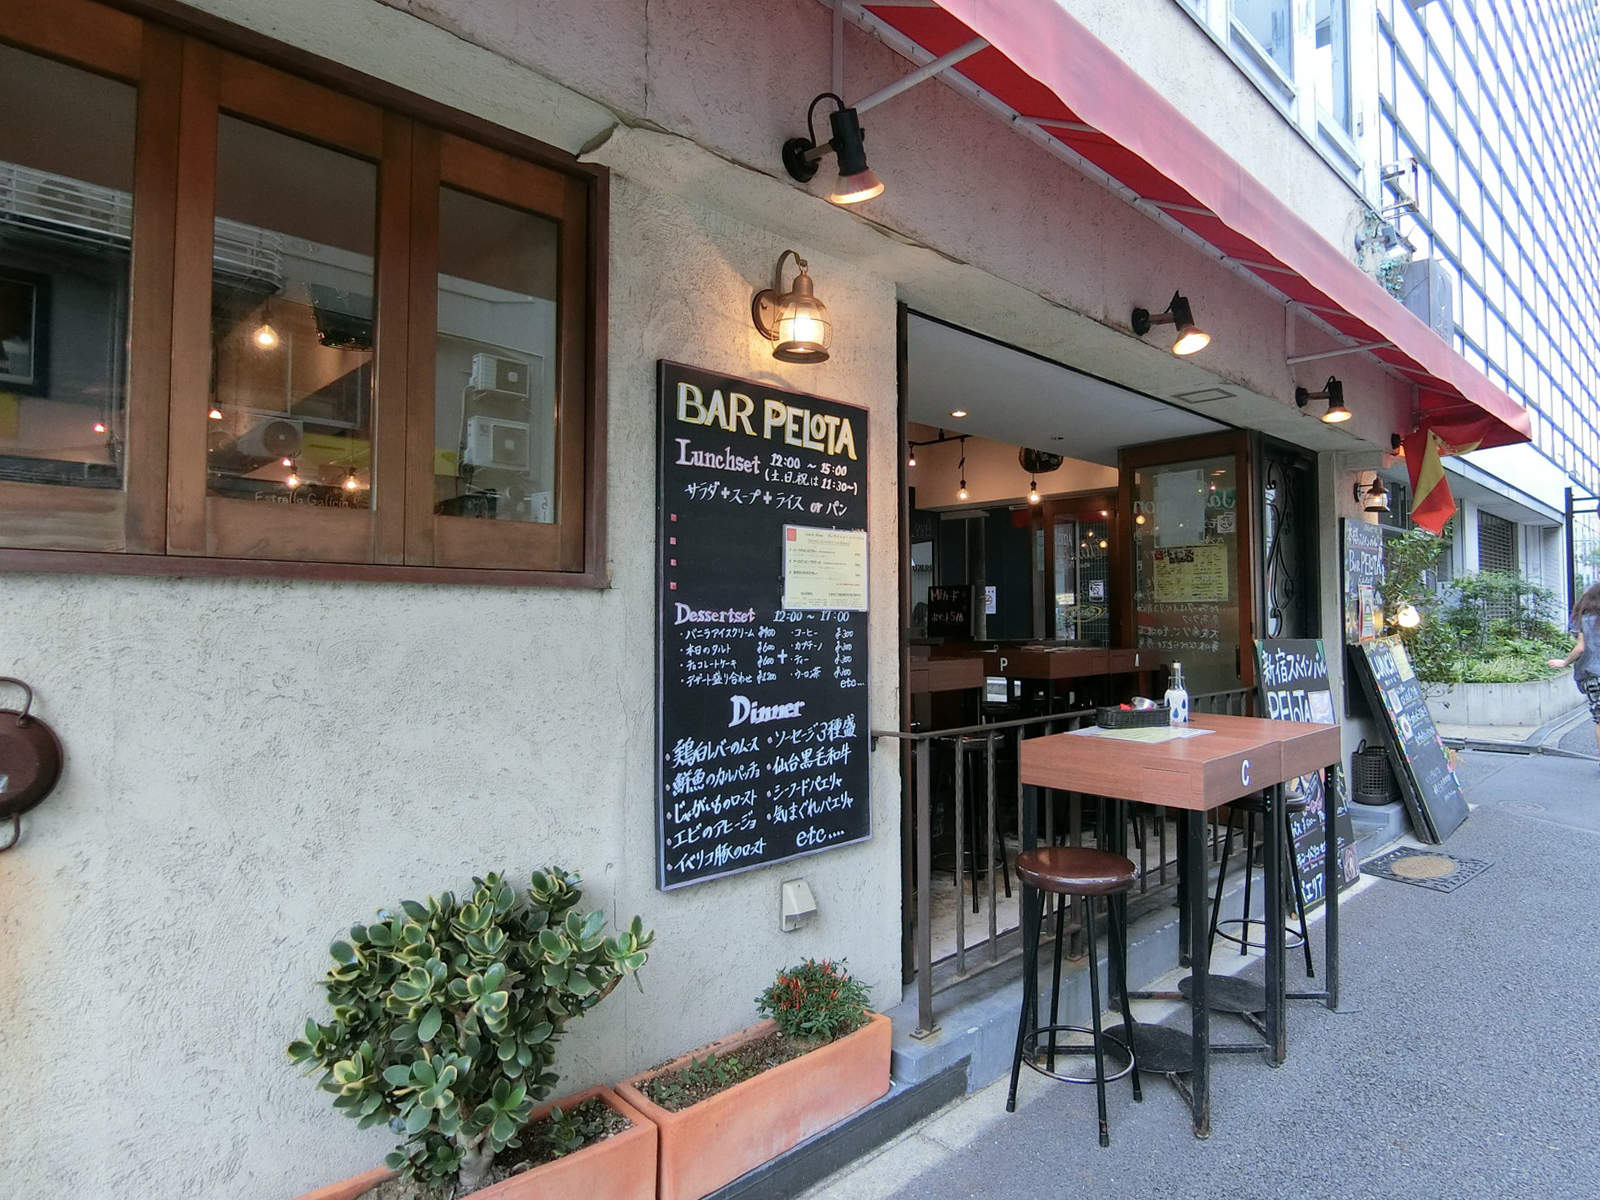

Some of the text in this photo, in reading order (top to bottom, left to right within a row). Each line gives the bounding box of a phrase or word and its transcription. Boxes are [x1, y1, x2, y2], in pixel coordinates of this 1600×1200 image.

[677, 382, 857, 460] BAR PELOTA
[674, 437, 760, 474] Lunchset
[769, 453, 801, 470] 12:00
[820, 462, 848, 476] 15:00
[255, 491, 349, 508] Estrella Galicia
[810, 501, 823, 513] or
[825, 500, 848, 516] パン
[1360, 551, 1383, 576] PELOTA
[674, 602, 756, 625] Dessertset
[773, 610, 802, 622] 12:00
[820, 610, 850, 622] 17:00
[685, 627, 755, 640] バニラアイスクリーム
[794, 628, 819, 637] コーヒー
[685, 643, 732, 657] 本日のタルト
[686, 659, 738, 672] チョコレートケーキ
[1000, 657, 1008, 672] P
[1369, 651, 1398, 679] LUNCH
[686, 670, 753, 687] デザート盛り合わせ
[728, 694, 806, 728] Dinner
[774, 713, 857, 748] ソーセージ3種盛
[772, 742, 852, 775] 仙台黒毛和牛
[672, 761, 761, 797] 鮮魚のカルパッチョ
[1241, 759, 1250, 787] C
[673, 788, 758, 824] じゃがいものロースト
[672, 811, 757, 849] エビのアヒージョ
[674, 837, 767, 873] イベリコ豚のロースト
